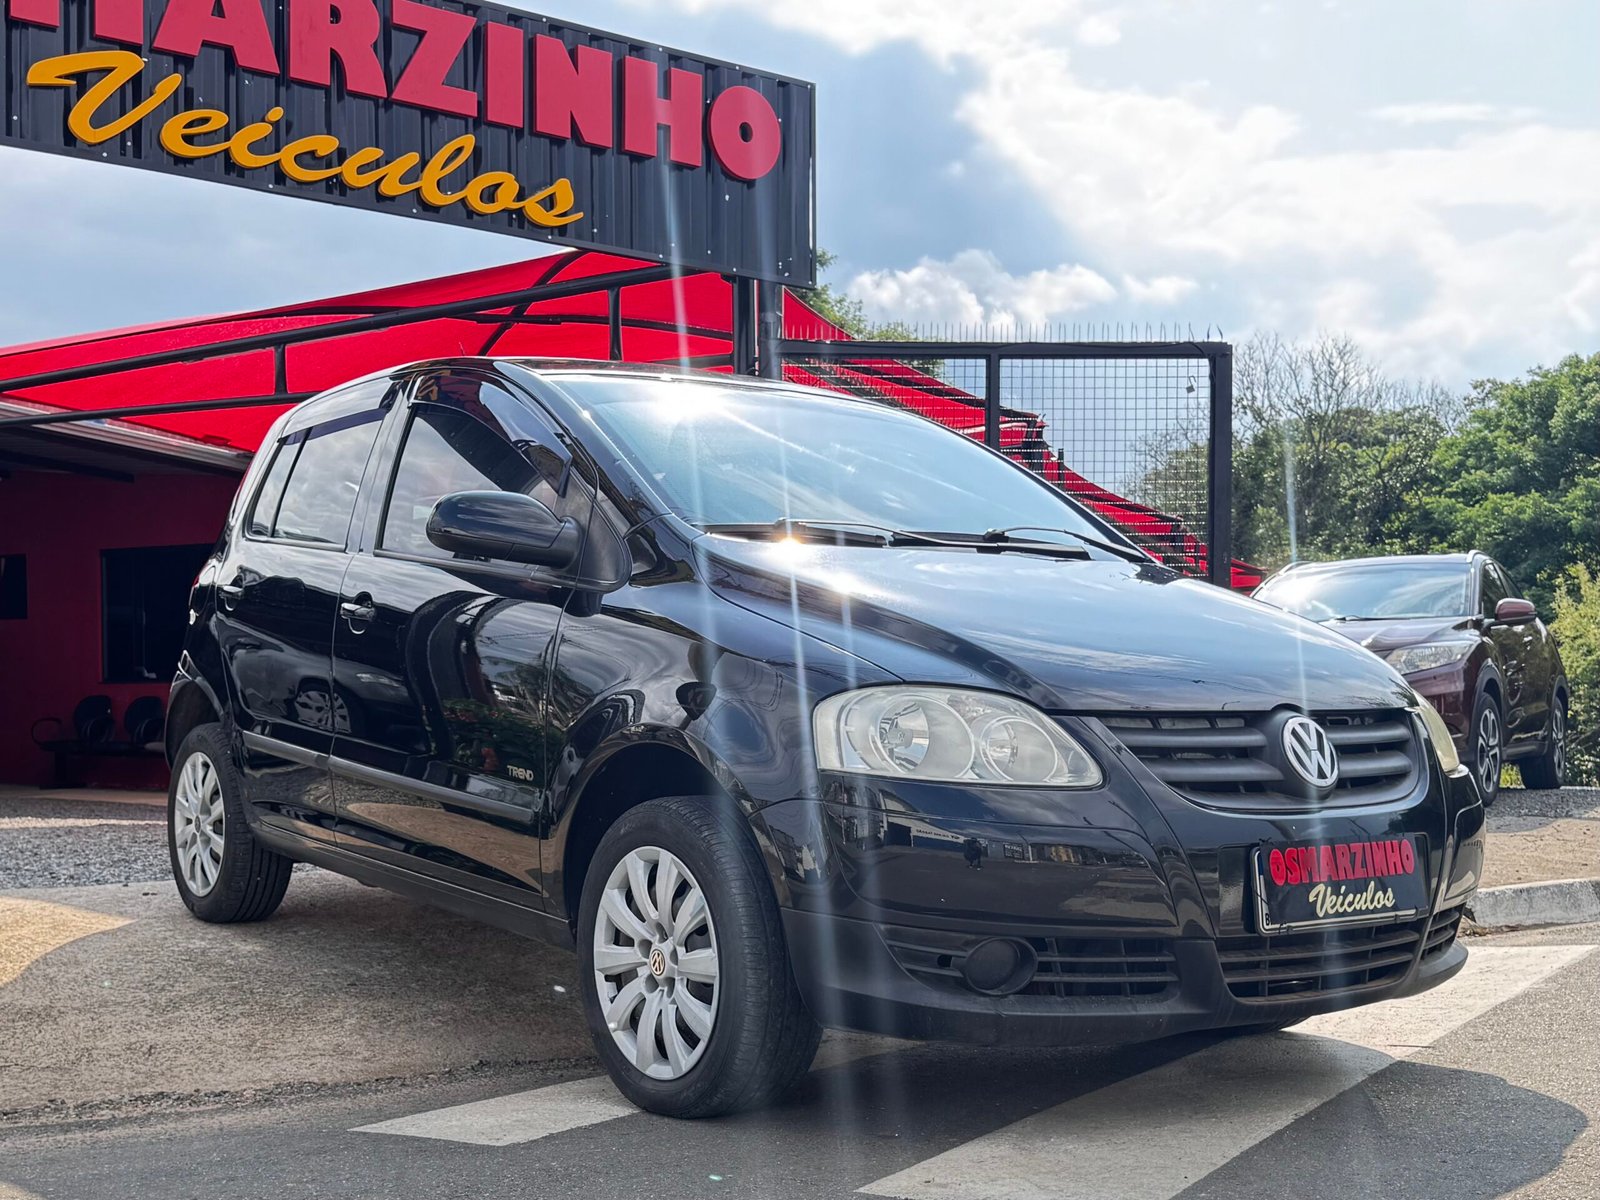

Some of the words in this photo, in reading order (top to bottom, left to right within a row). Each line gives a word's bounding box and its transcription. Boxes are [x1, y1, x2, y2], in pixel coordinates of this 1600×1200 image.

[507, 765, 534, 781] TREND
[1283, 716, 1338, 787] VW
[1269, 839, 1415, 887] OSMARZINHO
